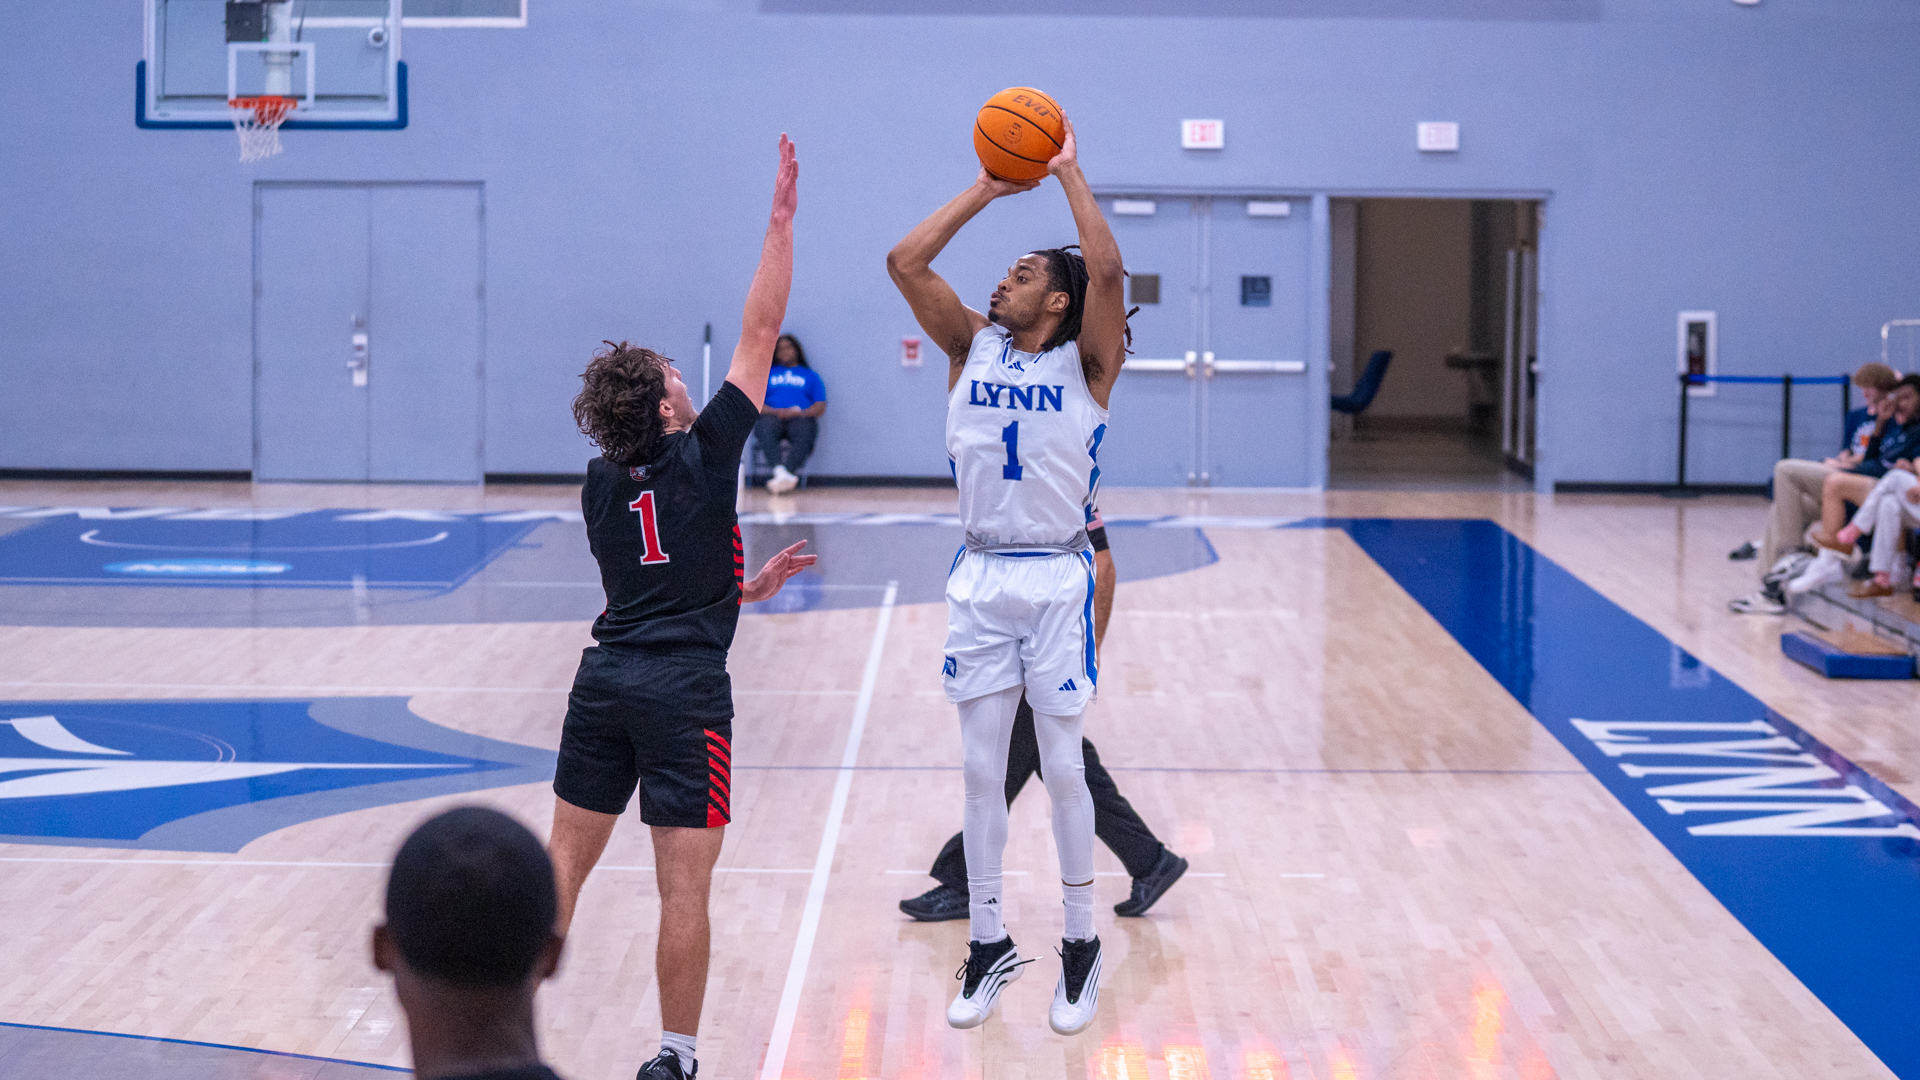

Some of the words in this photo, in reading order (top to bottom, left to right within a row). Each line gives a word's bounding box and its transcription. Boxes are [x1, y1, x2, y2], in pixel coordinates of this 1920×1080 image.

[1012, 94, 1050, 117] EVO
[969, 379, 1064, 412] LYNN
[1001, 420, 1023, 481] 1
[629, 490, 670, 565] 1
[1569, 718, 1920, 839] LYNN
